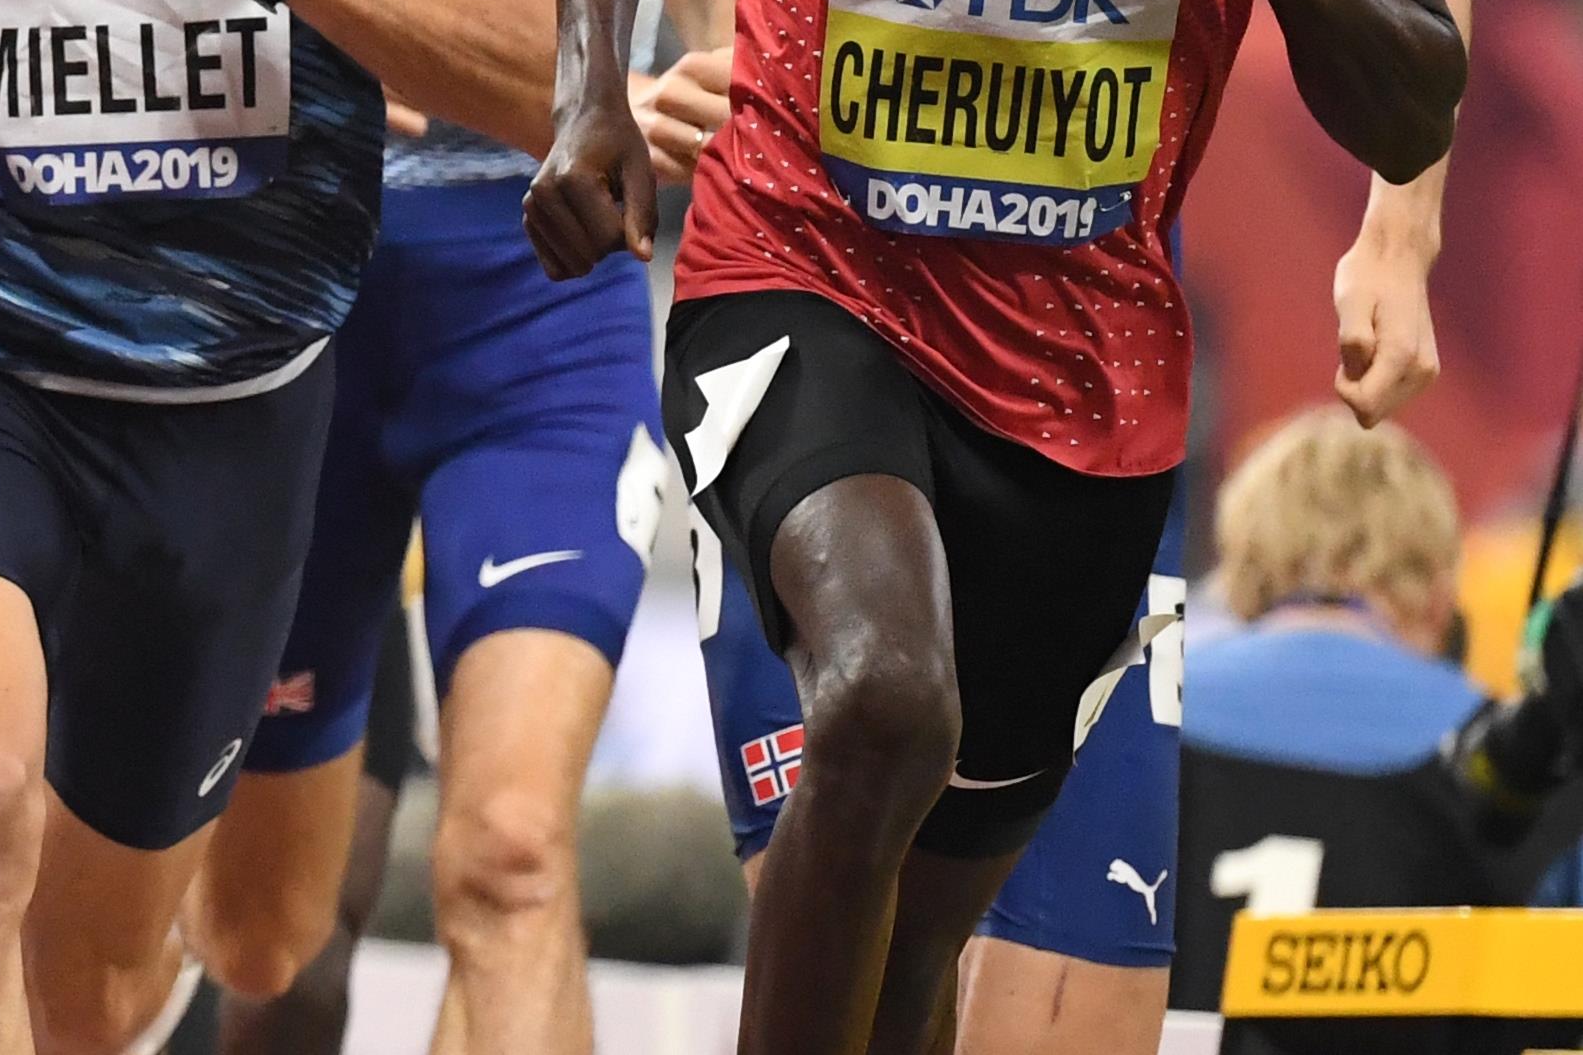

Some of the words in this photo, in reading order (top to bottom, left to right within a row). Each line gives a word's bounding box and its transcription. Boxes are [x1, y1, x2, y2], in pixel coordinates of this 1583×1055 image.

[830, 40, 1153, 163] CHERUIYOT
[5, 146, 238, 195] DOHA2019
[1261, 927, 1431, 996] SEIKO
